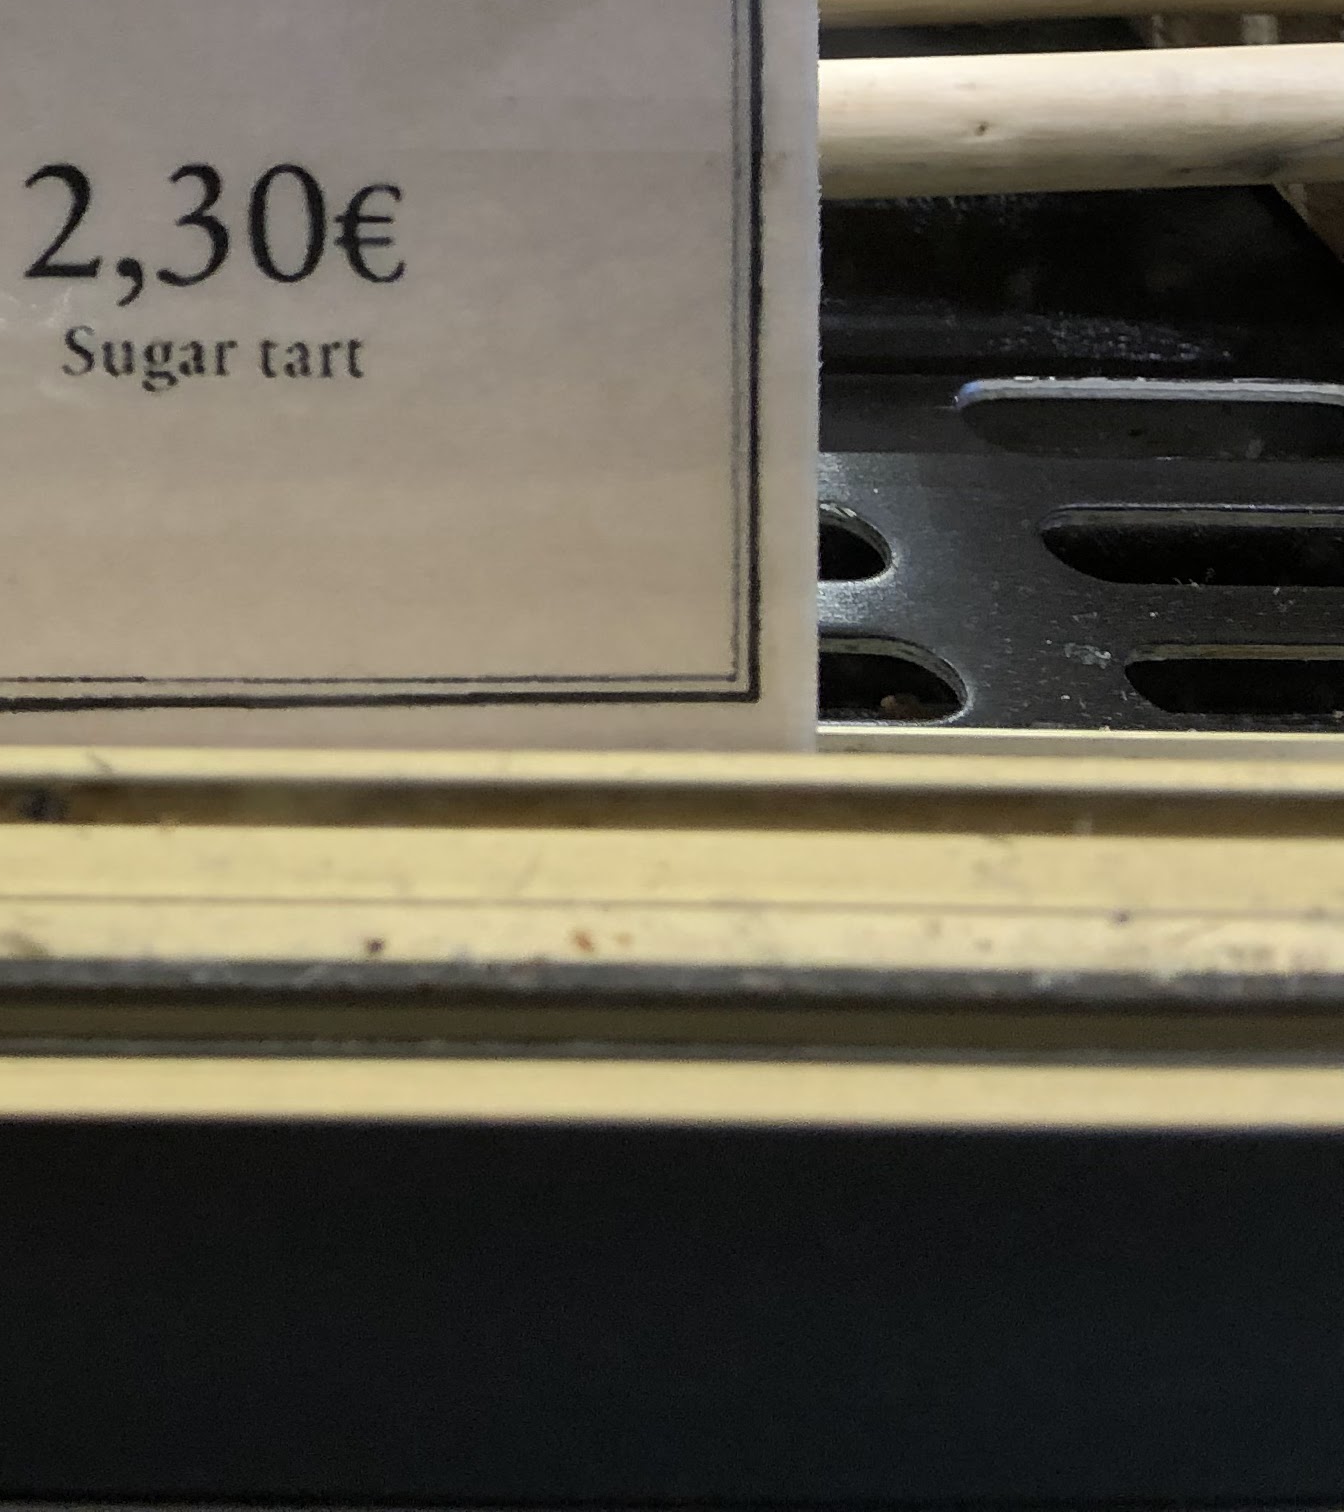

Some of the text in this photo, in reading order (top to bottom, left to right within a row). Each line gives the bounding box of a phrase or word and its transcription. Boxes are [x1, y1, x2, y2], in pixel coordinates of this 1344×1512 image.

[24, 162, 406, 307] 2,30€
[61, 325, 364, 392] Sugar tart
